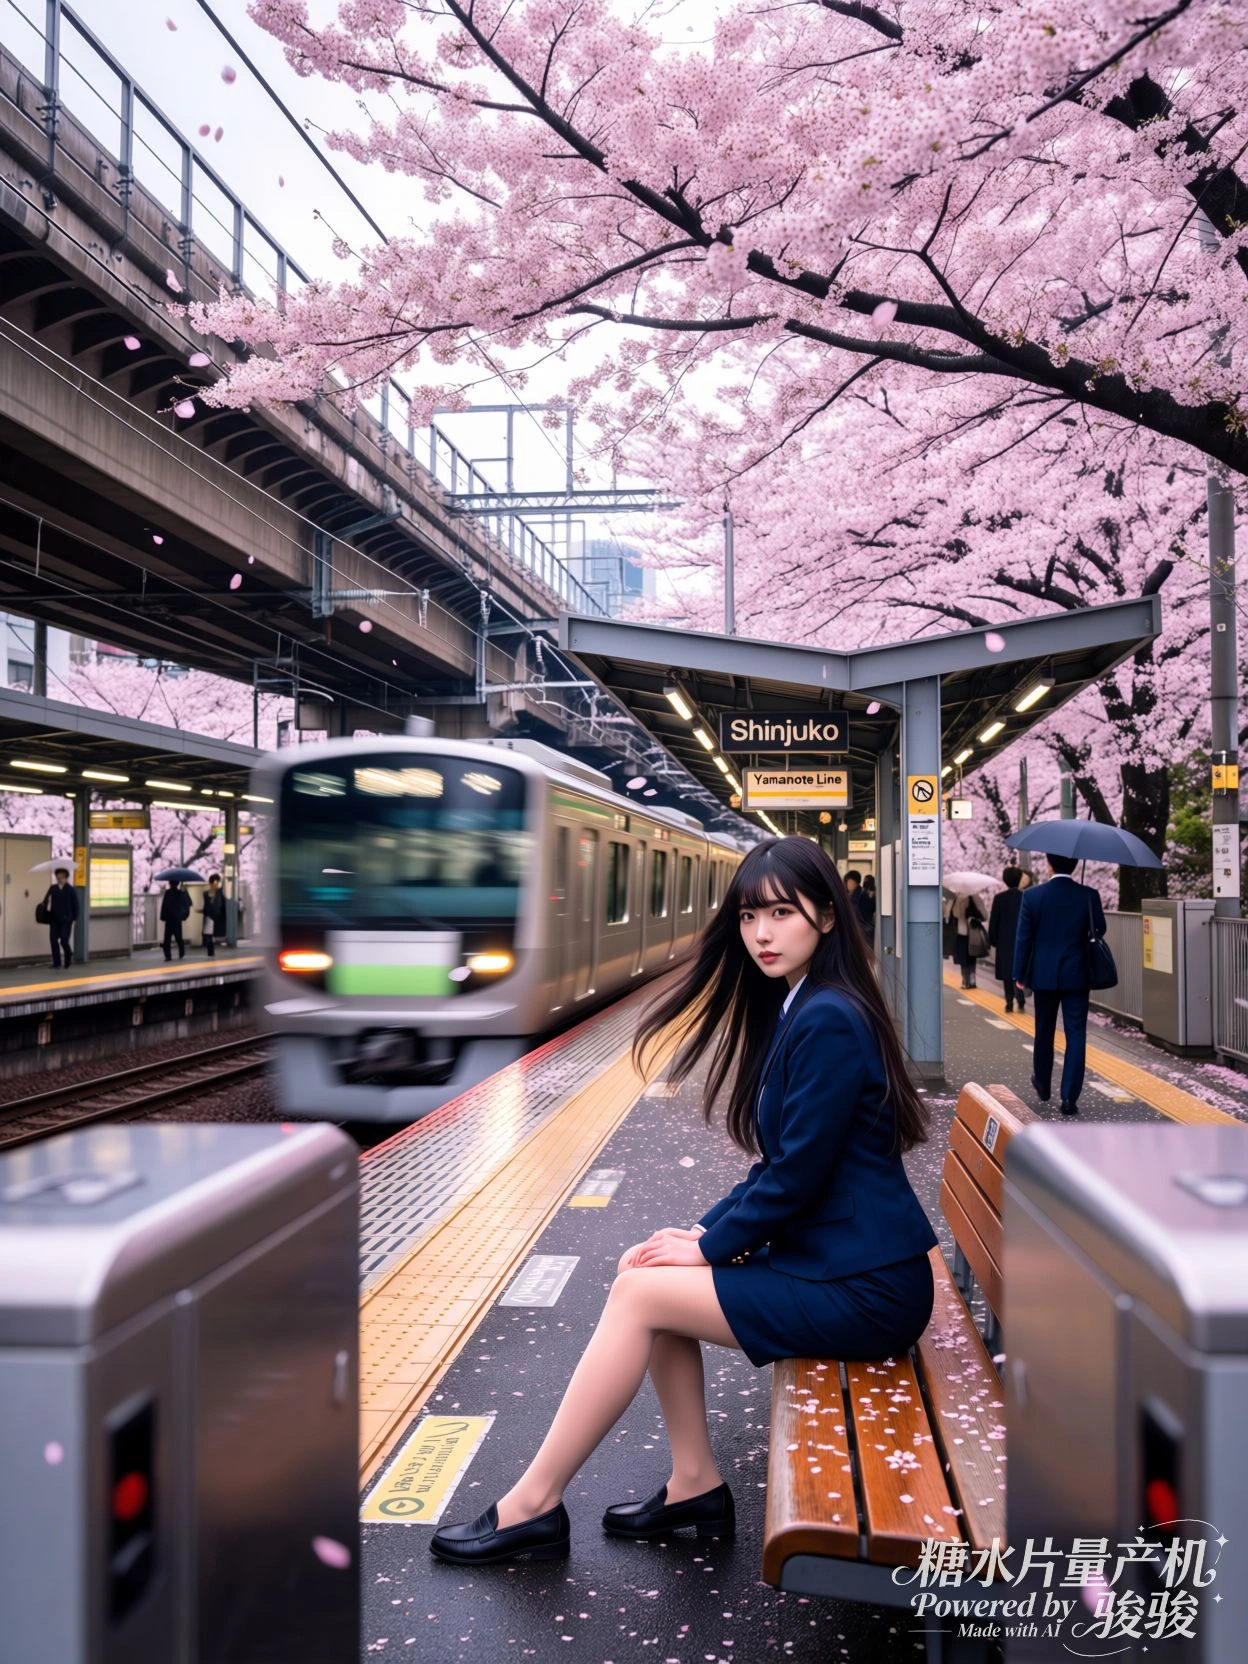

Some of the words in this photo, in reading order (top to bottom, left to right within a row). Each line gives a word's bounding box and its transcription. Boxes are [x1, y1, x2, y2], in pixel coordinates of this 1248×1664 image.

[731, 719, 839, 746] Shinjuko
[754, 774, 813, 785] Yamanote
[817, 774, 842, 785] Line
